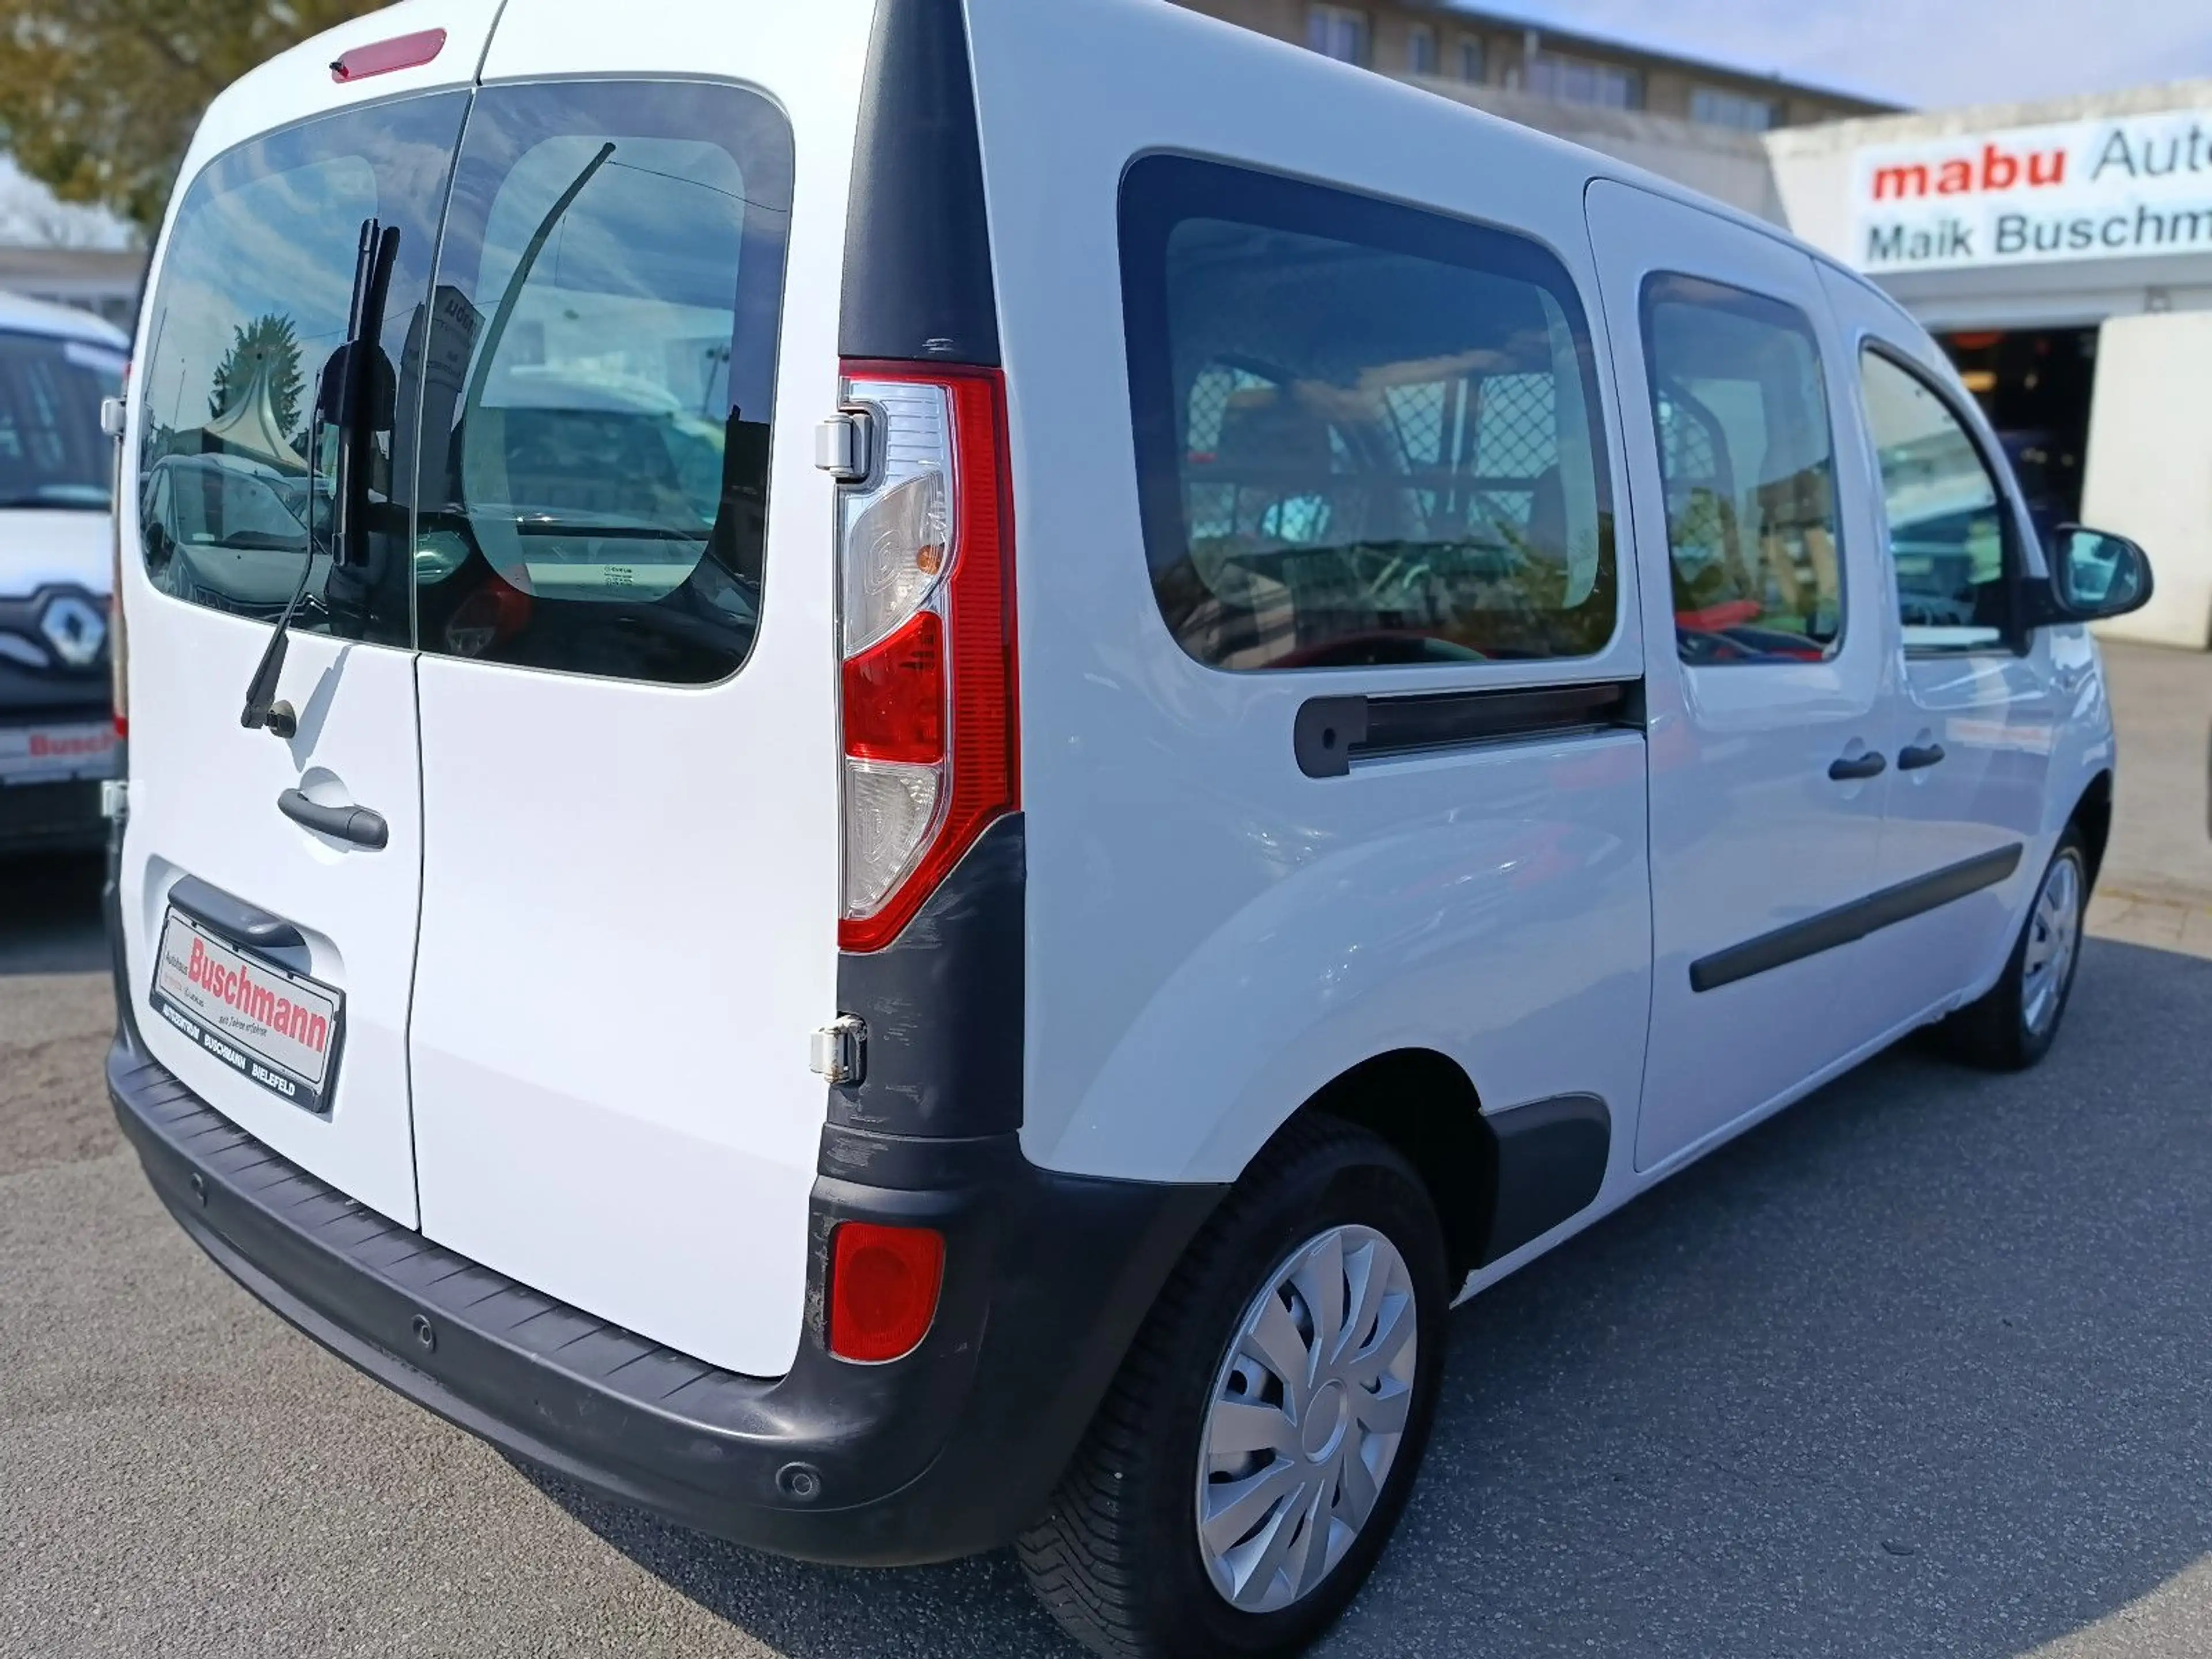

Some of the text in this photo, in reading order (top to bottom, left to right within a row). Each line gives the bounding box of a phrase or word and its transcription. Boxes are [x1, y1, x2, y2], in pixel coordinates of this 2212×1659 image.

[1873, 123, 2212, 201] mabu Aut
[1868, 217, 1974, 262] Maik
[188, 935, 327, 1053] Buschmann
[204, 1033, 247, 1070] BUSCHMANN
[251, 1063, 296, 1096] BIELEFELD
